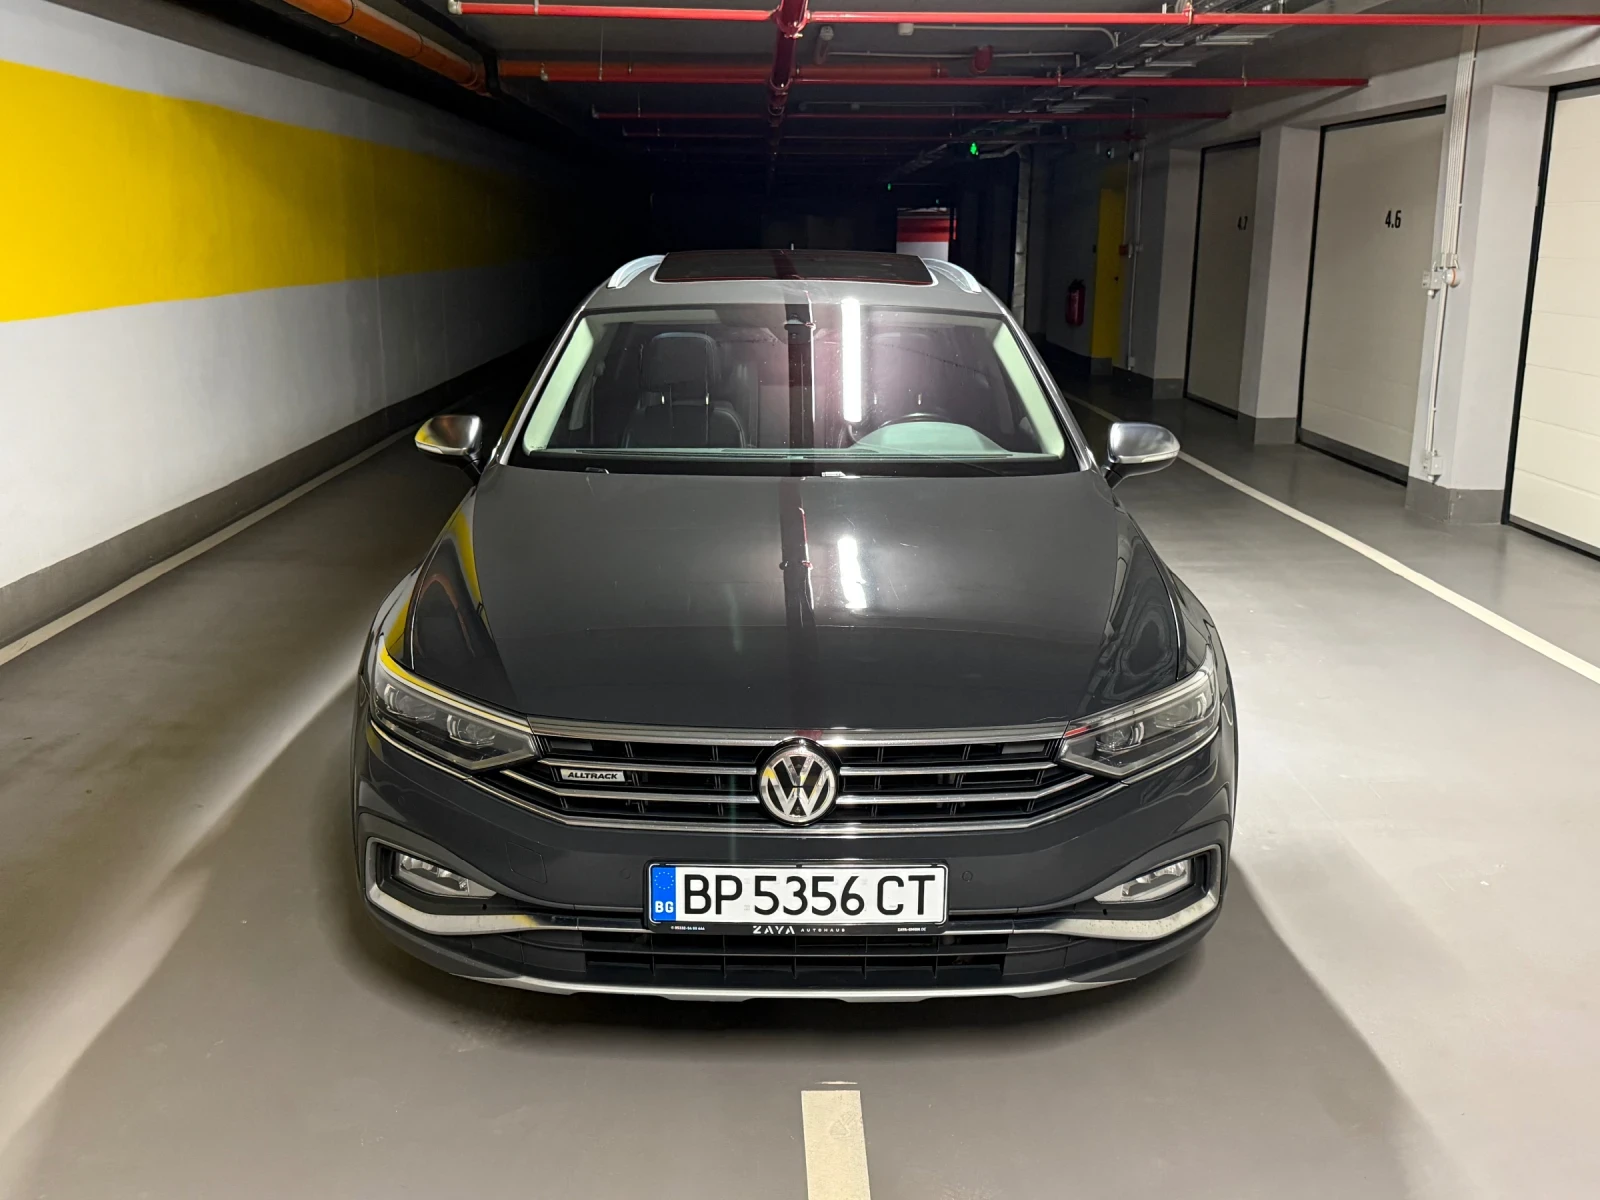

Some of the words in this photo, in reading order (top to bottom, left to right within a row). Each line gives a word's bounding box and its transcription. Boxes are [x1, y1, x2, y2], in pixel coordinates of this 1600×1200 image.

[1237, 216, 1248, 230] 4.7
[1385, 210, 1401, 228] 4.6
[763, 750, 834, 820] VW
[684, 874, 743, 915] BP
[754, 875, 865, 916] 5356
[877, 875, 936, 915] CT
[655, 901, 674, 913] BG
[752, 925, 796, 935] ZAYA
